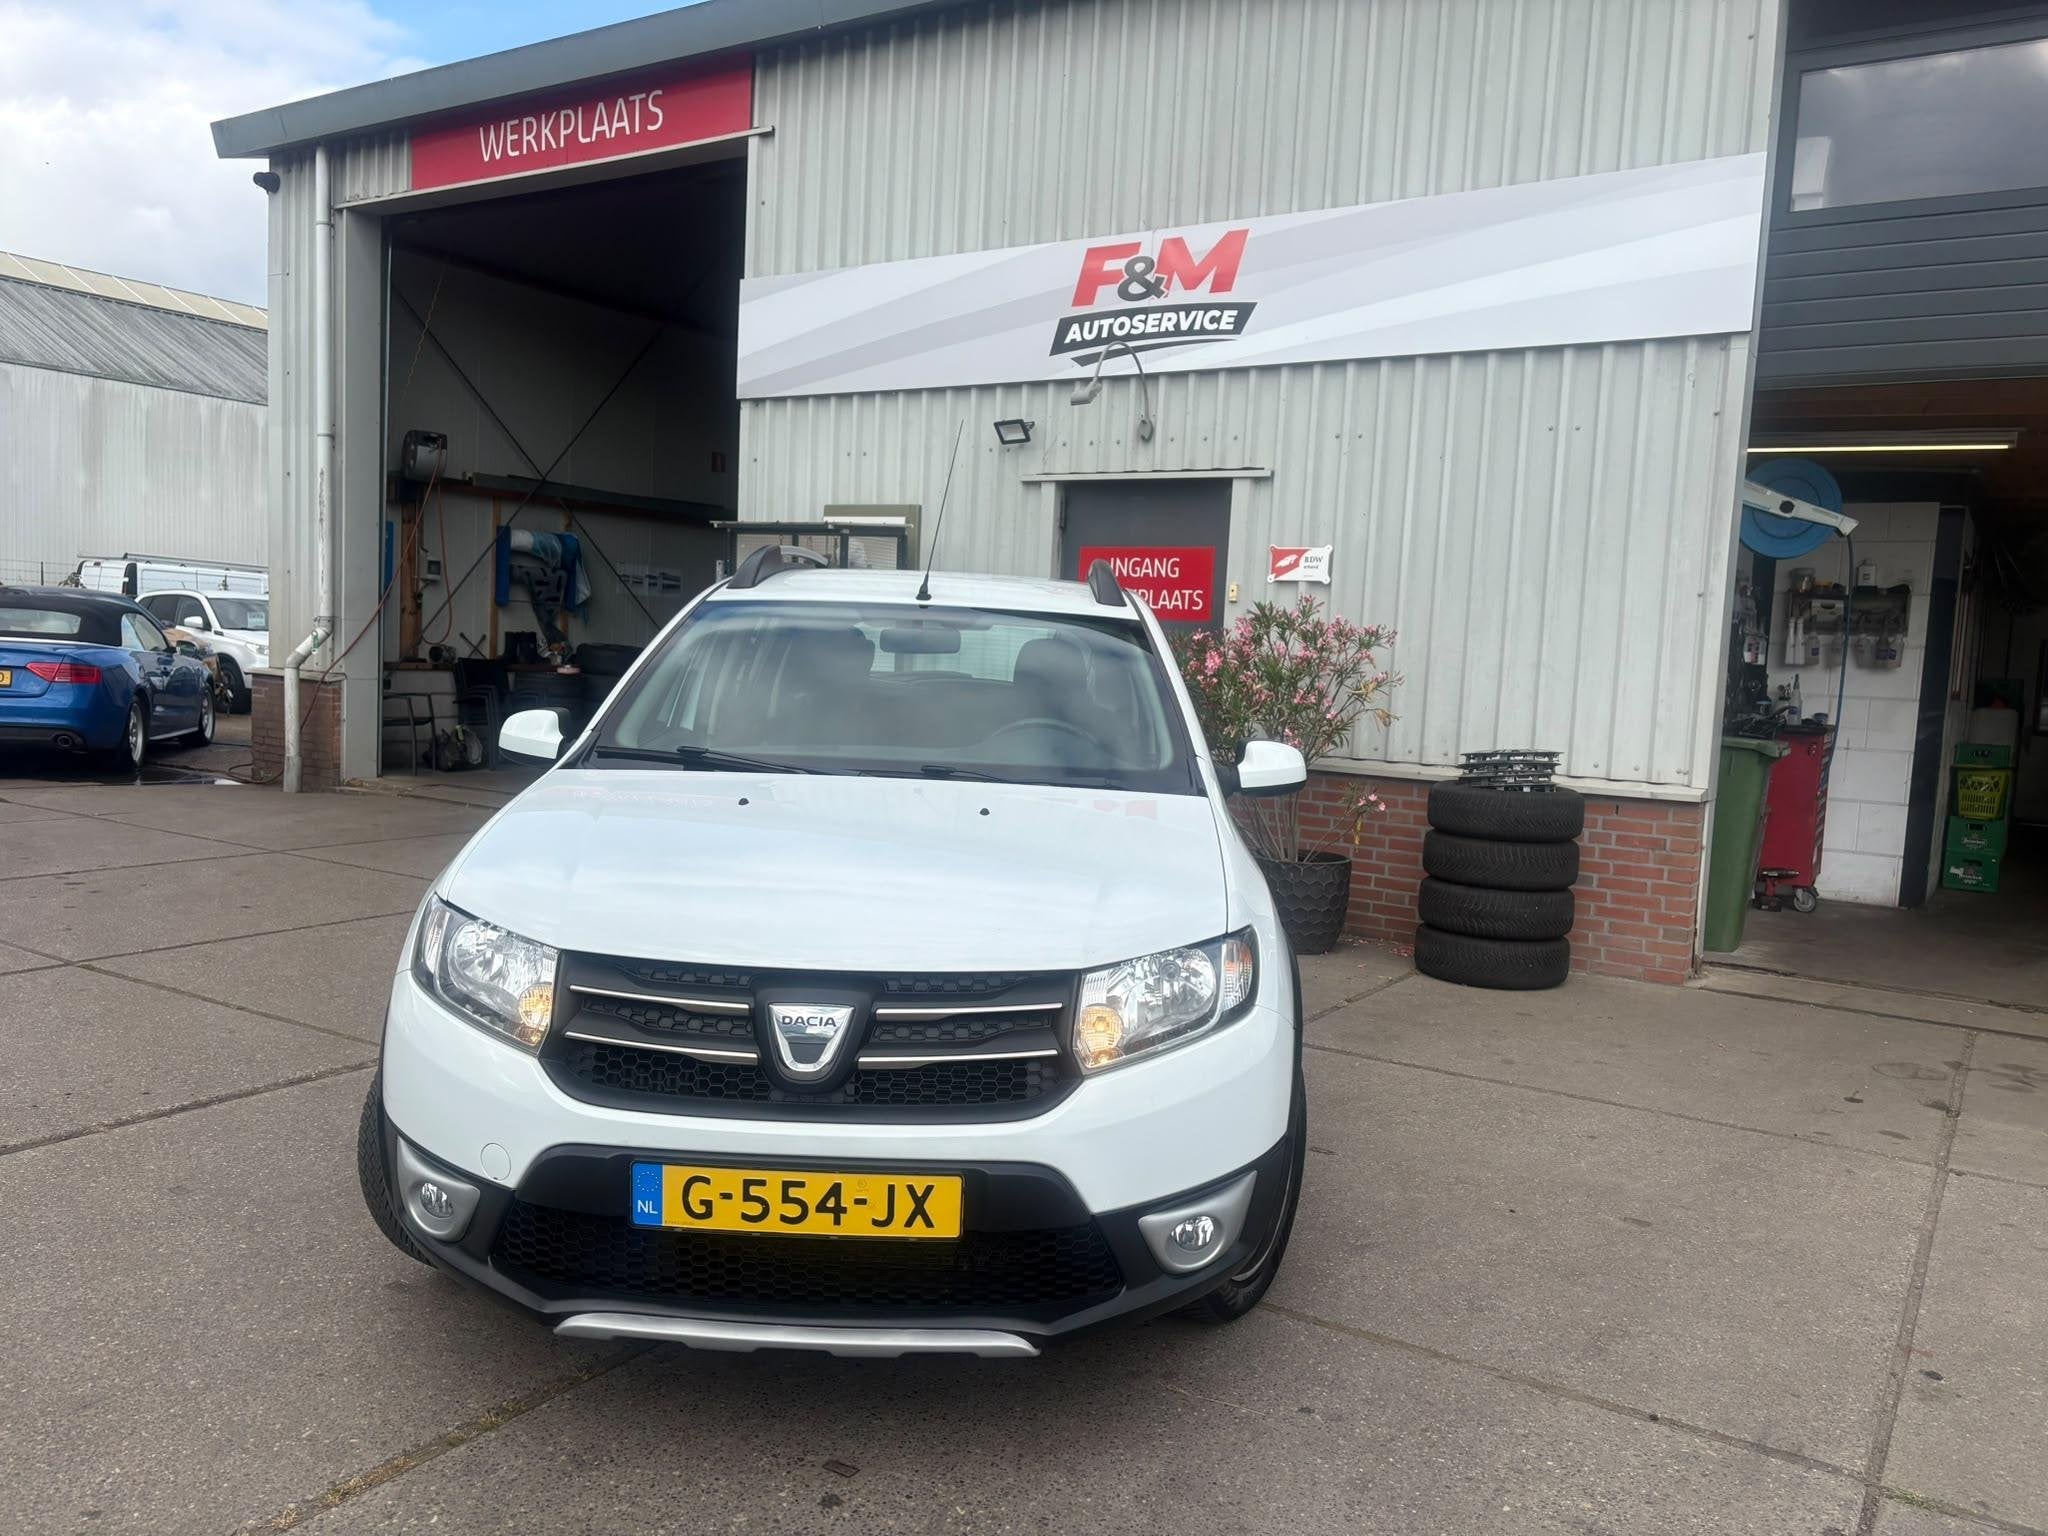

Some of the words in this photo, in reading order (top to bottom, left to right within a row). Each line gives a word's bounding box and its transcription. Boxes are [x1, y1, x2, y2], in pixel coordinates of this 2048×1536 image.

[479, 89, 664, 162] WERKPLAATS
[1071, 229, 1250, 307] F&M
[1064, 310, 1239, 344] AUTOSERVICE
[1110, 557, 1180, 578] INGANG
[1131, 588, 1204, 610] PLAATS
[781, 1015, 837, 1027] DACIA
[637, 1199, 659, 1215] NL
[681, 1174, 936, 1229] G-554-JX
